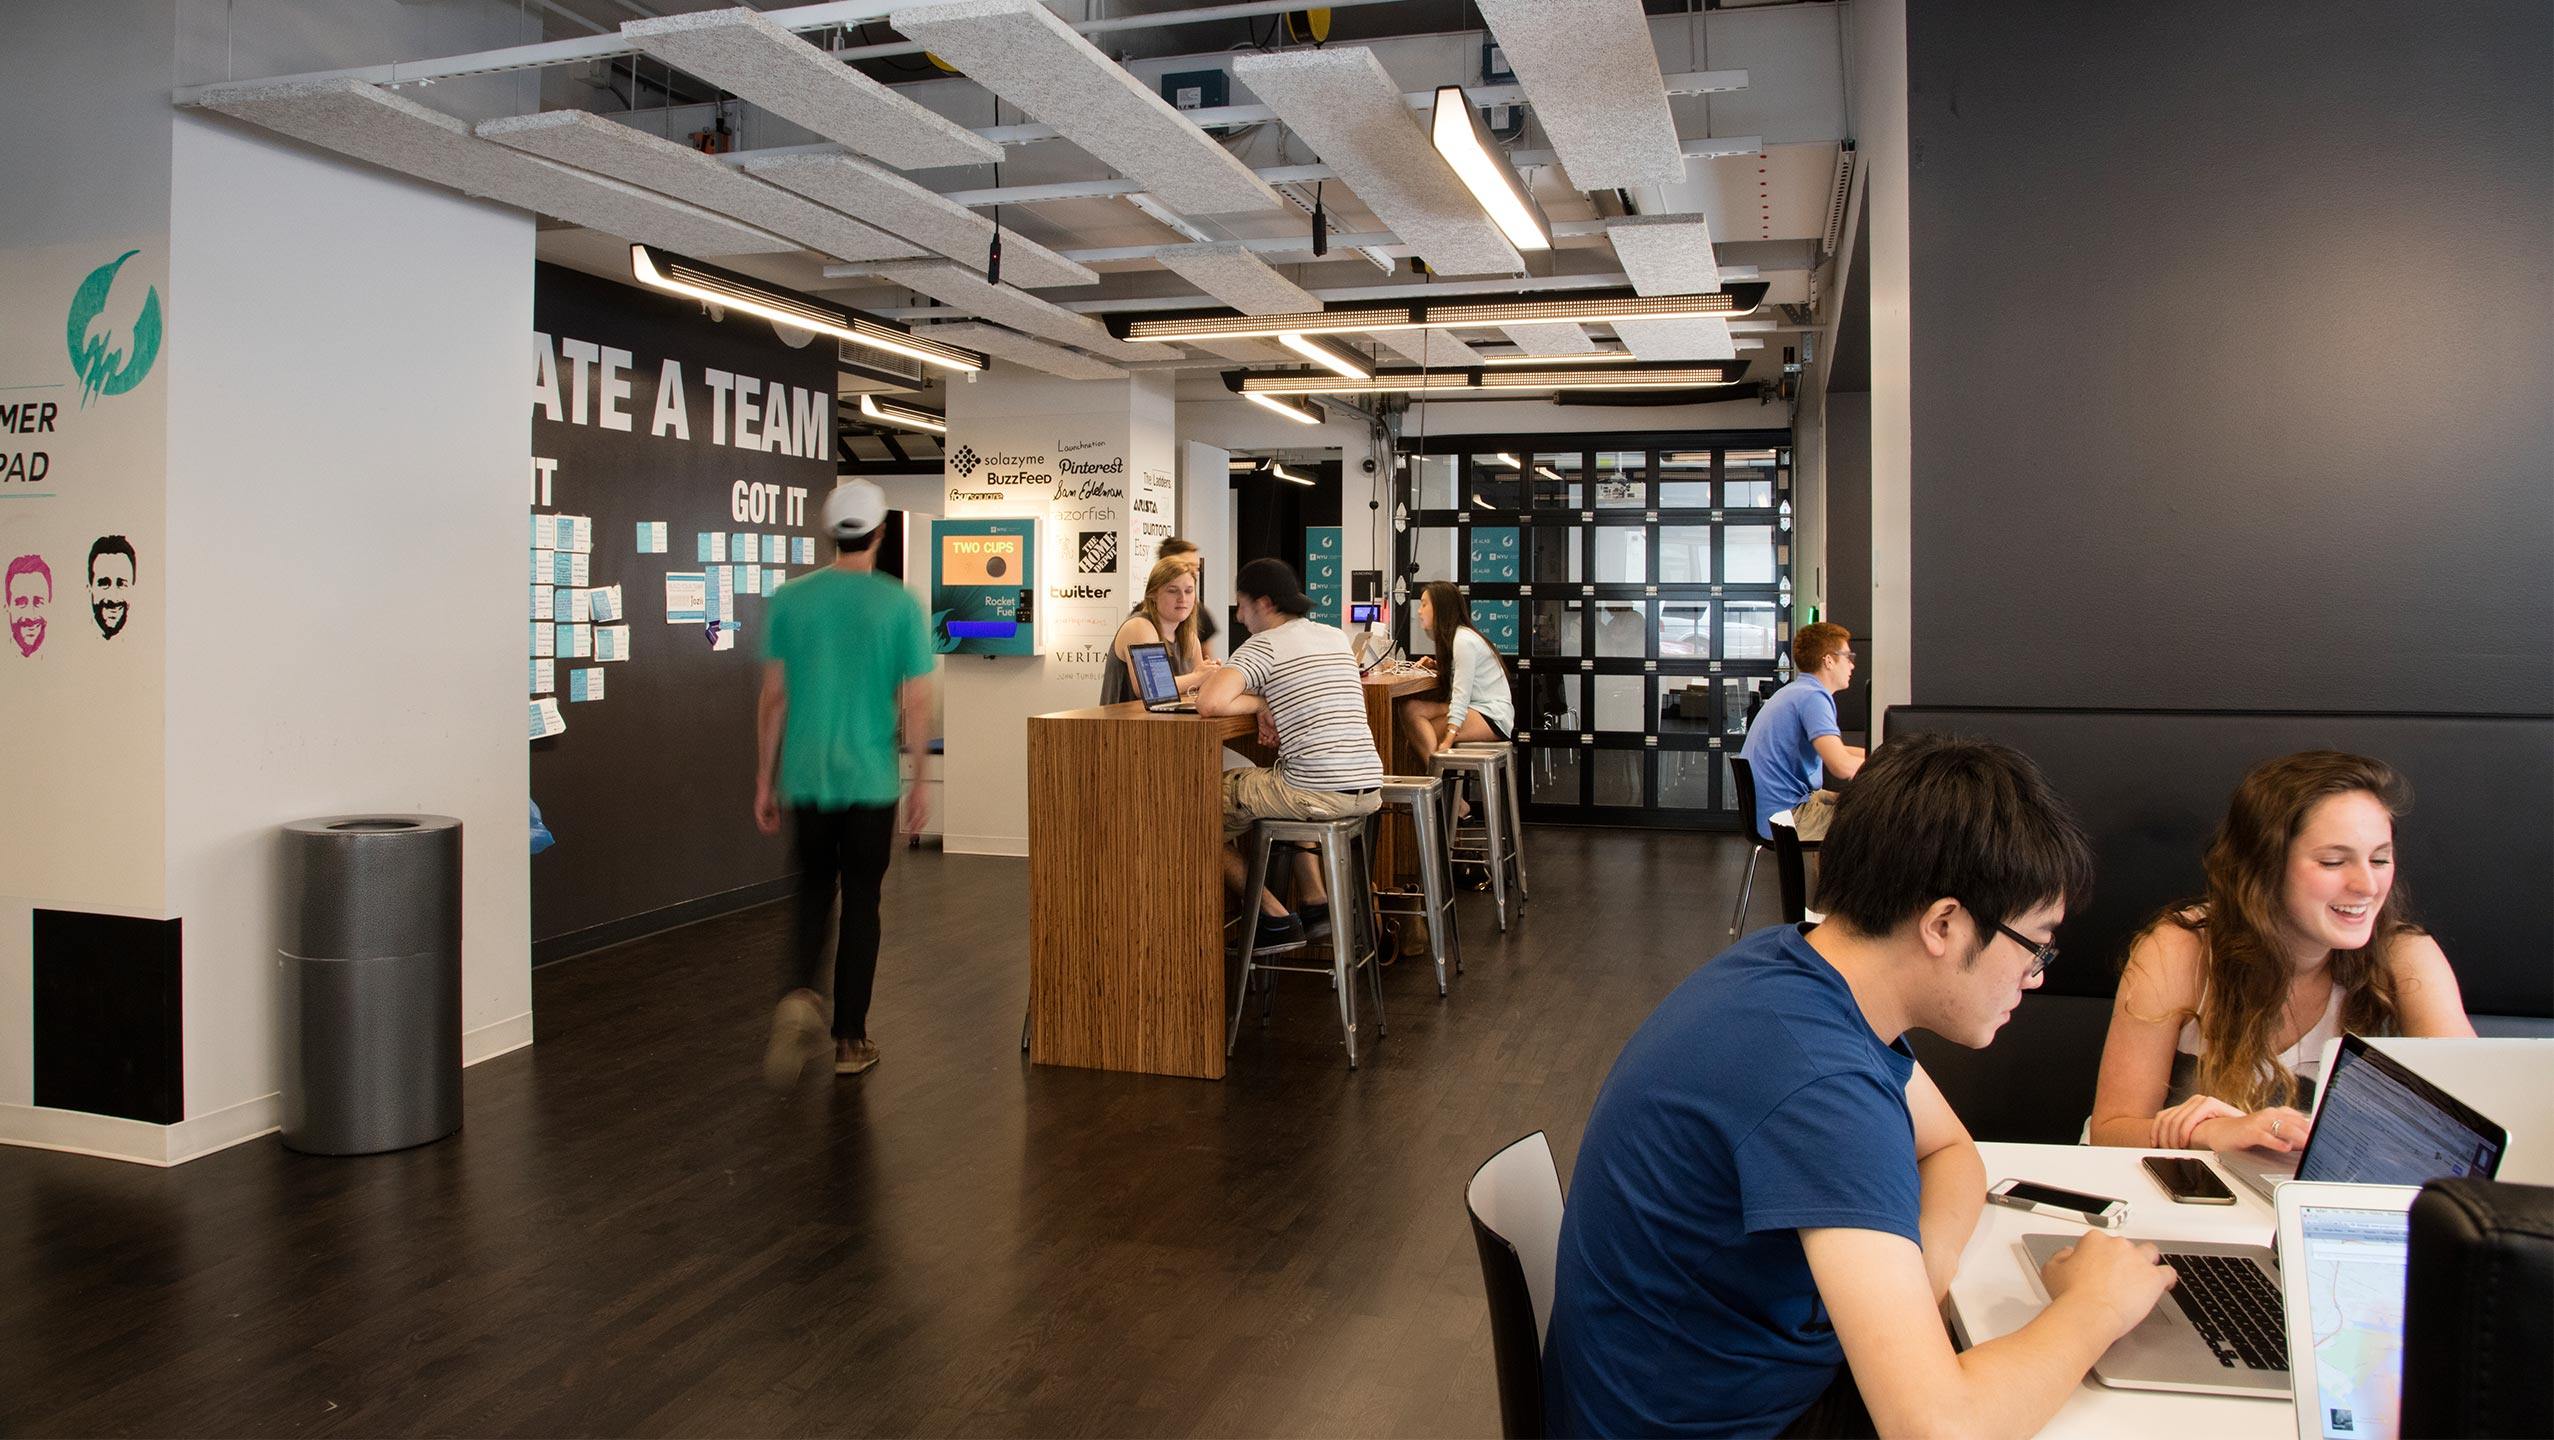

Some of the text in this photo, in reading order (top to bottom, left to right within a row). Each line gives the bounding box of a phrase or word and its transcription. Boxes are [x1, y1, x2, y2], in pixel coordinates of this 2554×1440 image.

[532, 331, 829, 461] ATE A TEAM
[984, 451, 1045, 469] solazyme
[1059, 456, 1124, 476] Pinterest
[1053, 479, 1077, 501] Sam
[732, 479, 808, 527] GOT IT
[953, 542, 1015, 554] TWO CUPS
[1079, 530, 1118, 574] HOME
[1082, 535, 1099, 554] THE
[1093, 546, 1118, 574] DEPOT
[985, 595, 1016, 607] Rocket
[1049, 585, 1112, 599] twitter
[996, 607, 1016, 617] Fuel
